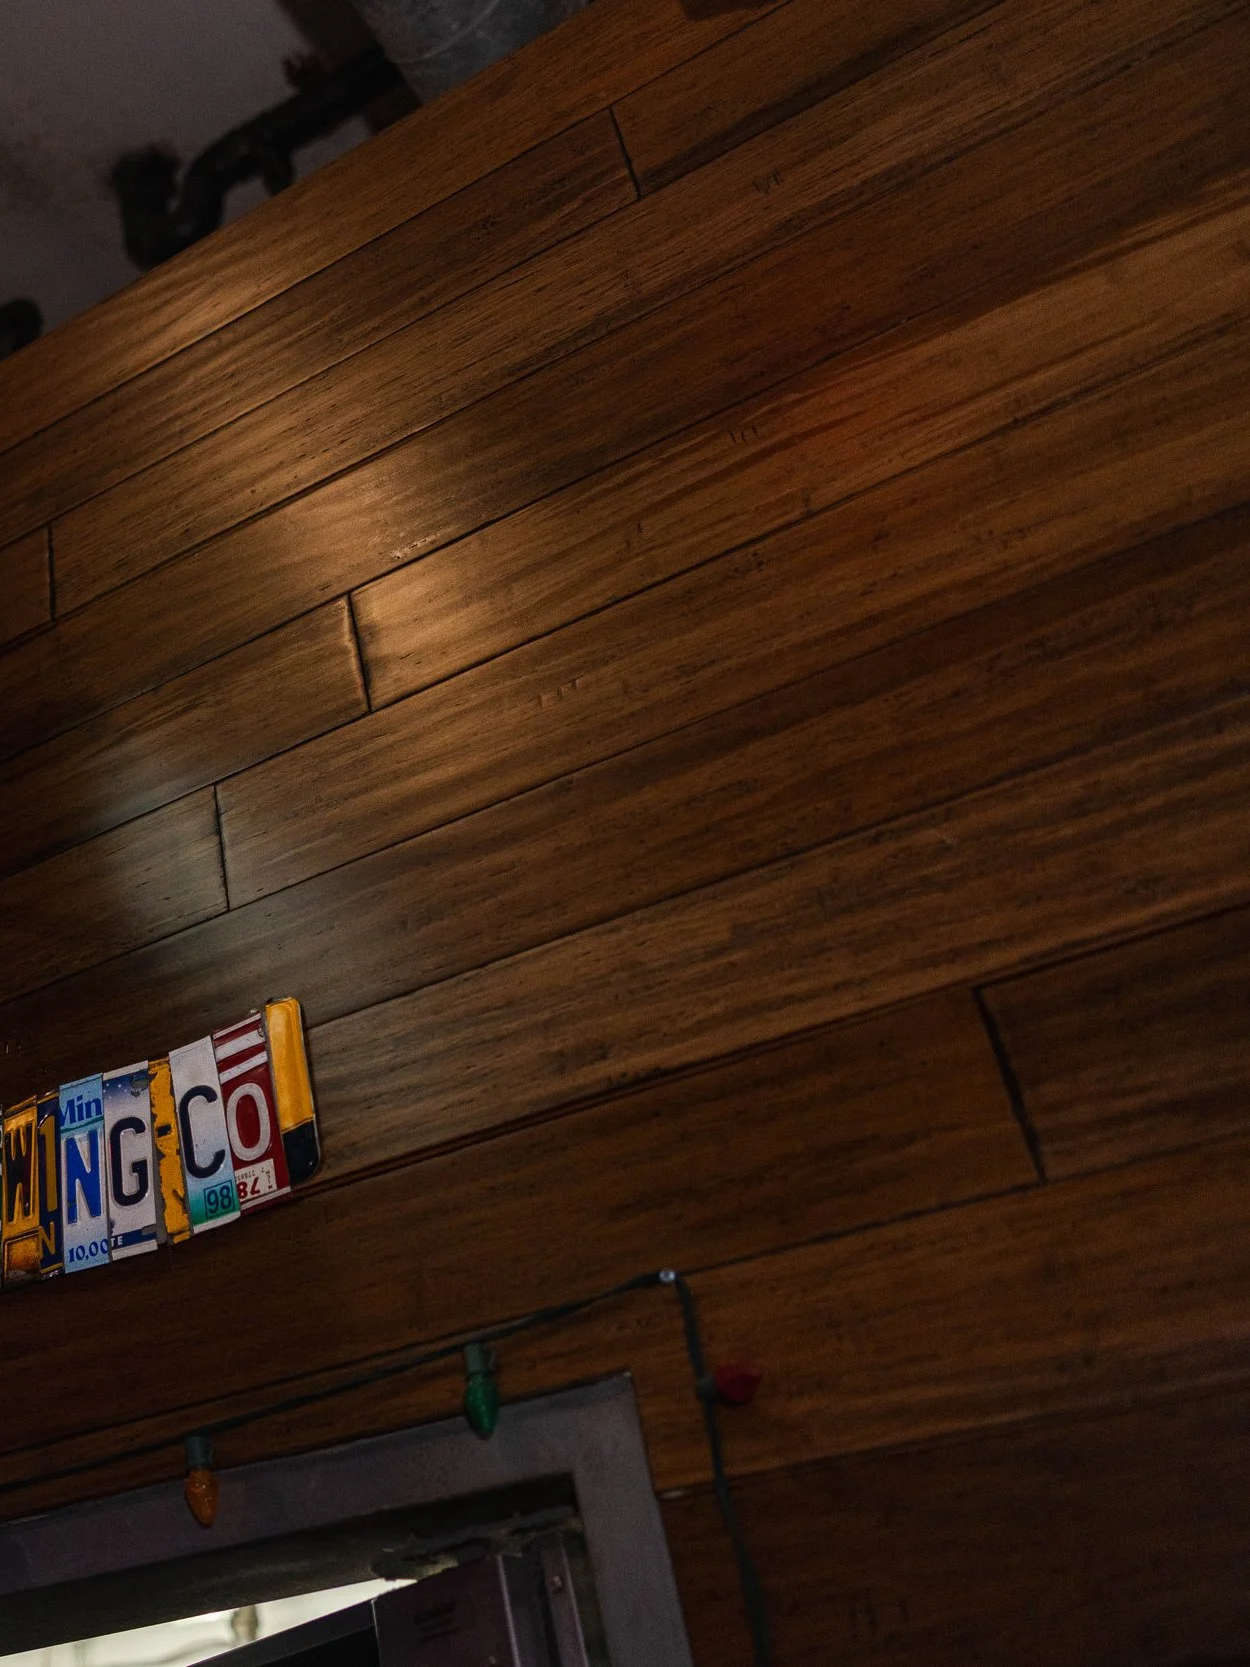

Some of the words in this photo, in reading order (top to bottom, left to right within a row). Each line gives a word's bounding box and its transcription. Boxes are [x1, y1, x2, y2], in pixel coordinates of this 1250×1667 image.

[179, 1082, 274, 1179] CO
[206, 1184, 233, 1213] 98
[68, 1238, 109, 1264] 10,00
